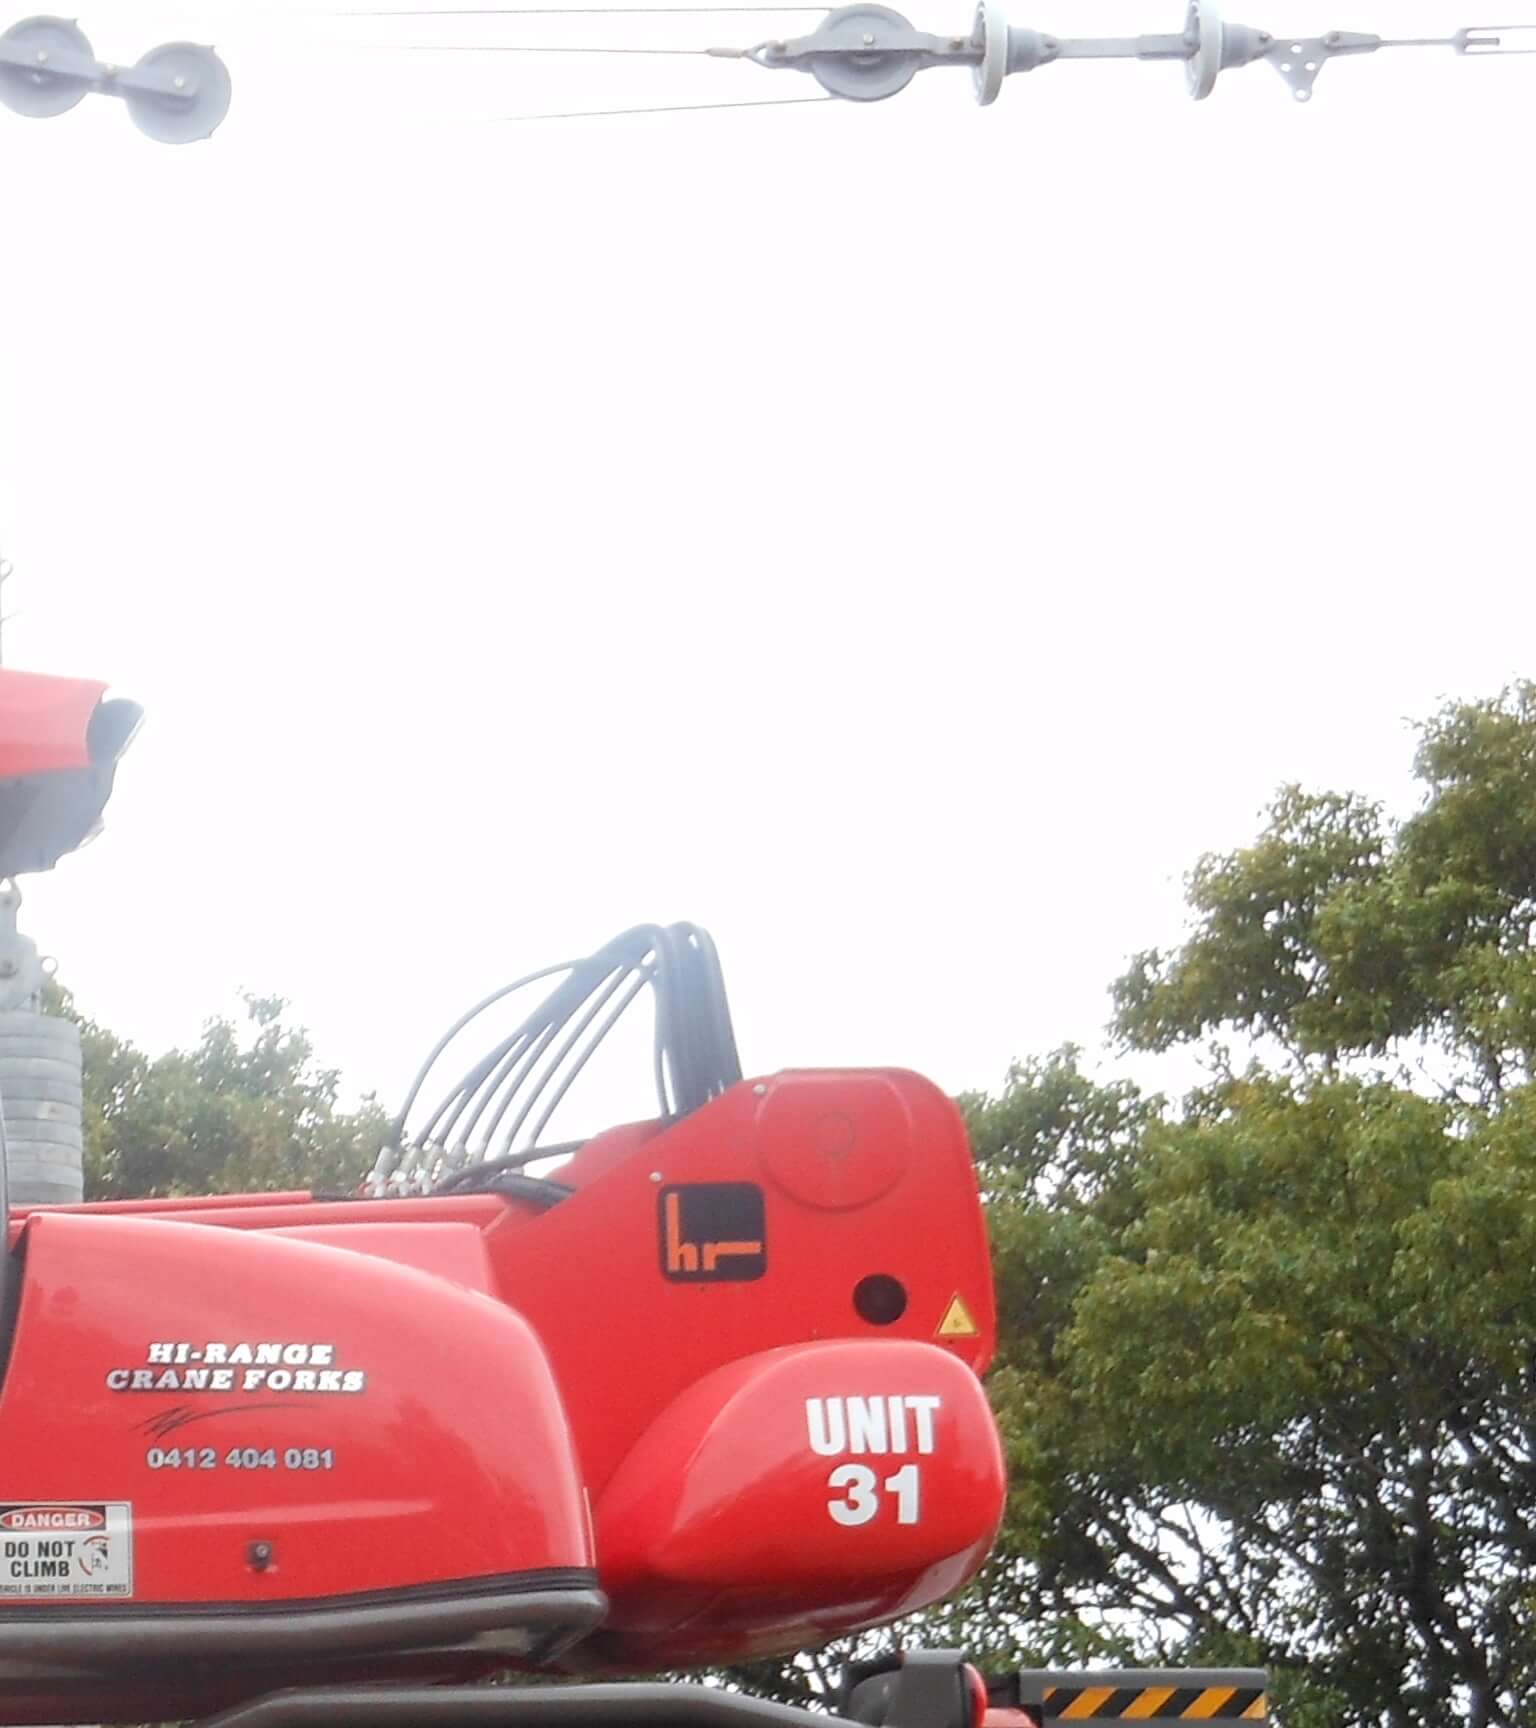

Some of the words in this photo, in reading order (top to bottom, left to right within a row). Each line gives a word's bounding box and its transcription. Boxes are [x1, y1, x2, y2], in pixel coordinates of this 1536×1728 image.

[146, 1343, 334, 1365] HI-RANGE
[105, 1369, 235, 1391] CRANE
[242, 1369, 365, 1393] FORKS
[804, 1396, 941, 1456] UNIT
[146, 1448, 217, 1469] 0412
[224, 1448, 277, 1469] 404
[283, 1448, 335, 1470] 081
[827, 1463, 921, 1526] 31
[10, 1513, 91, 1528] DANGER
[4, 1540, 30, 1558] DO
[37, 1540, 76, 1558] NOT
[10, 1560, 70, 1578] CLIMB
